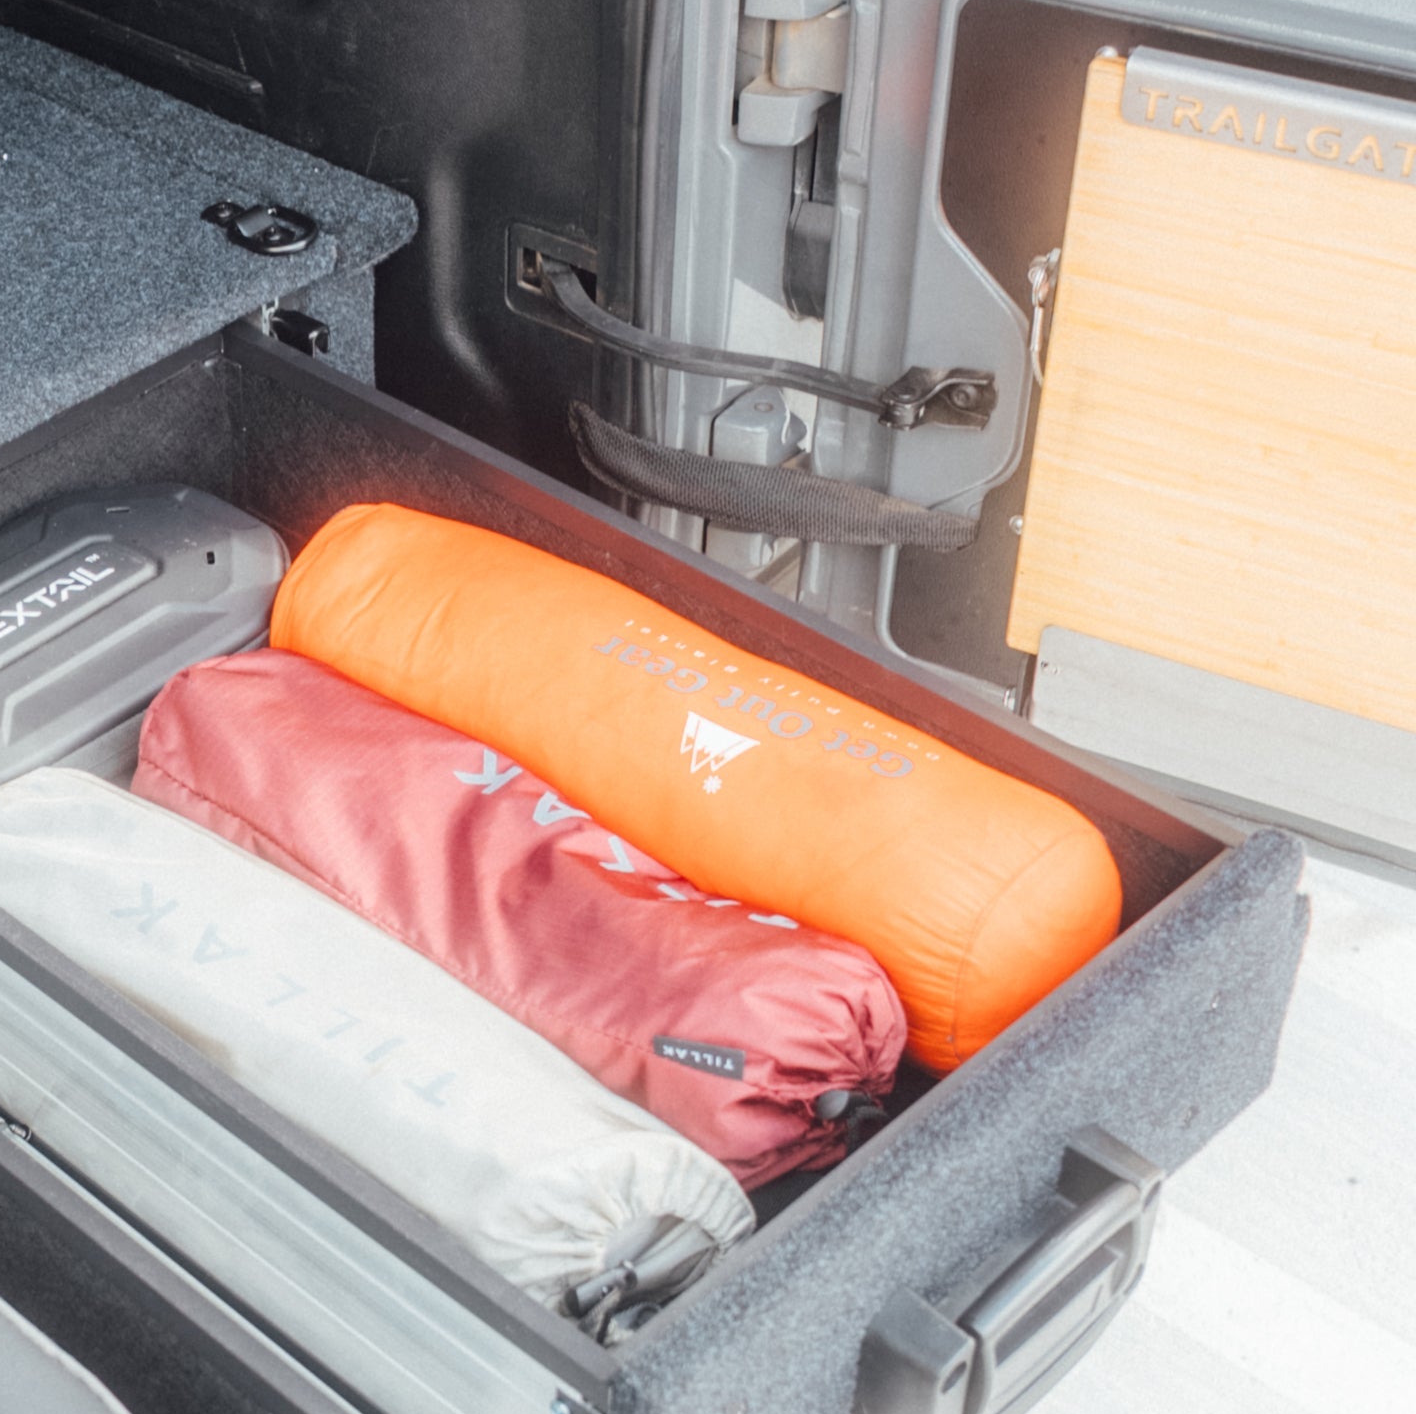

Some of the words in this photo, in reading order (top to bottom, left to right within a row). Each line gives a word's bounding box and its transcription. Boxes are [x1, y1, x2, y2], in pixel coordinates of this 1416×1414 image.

[593, 636, 709, 694] Gear
[624, 618, 739, 674] Blanket
[715, 685, 814, 739] Out
[821, 729, 914, 778] Get
[110, 882, 458, 1107] TILLAK
[662, 1044, 734, 1071] TILLAK
